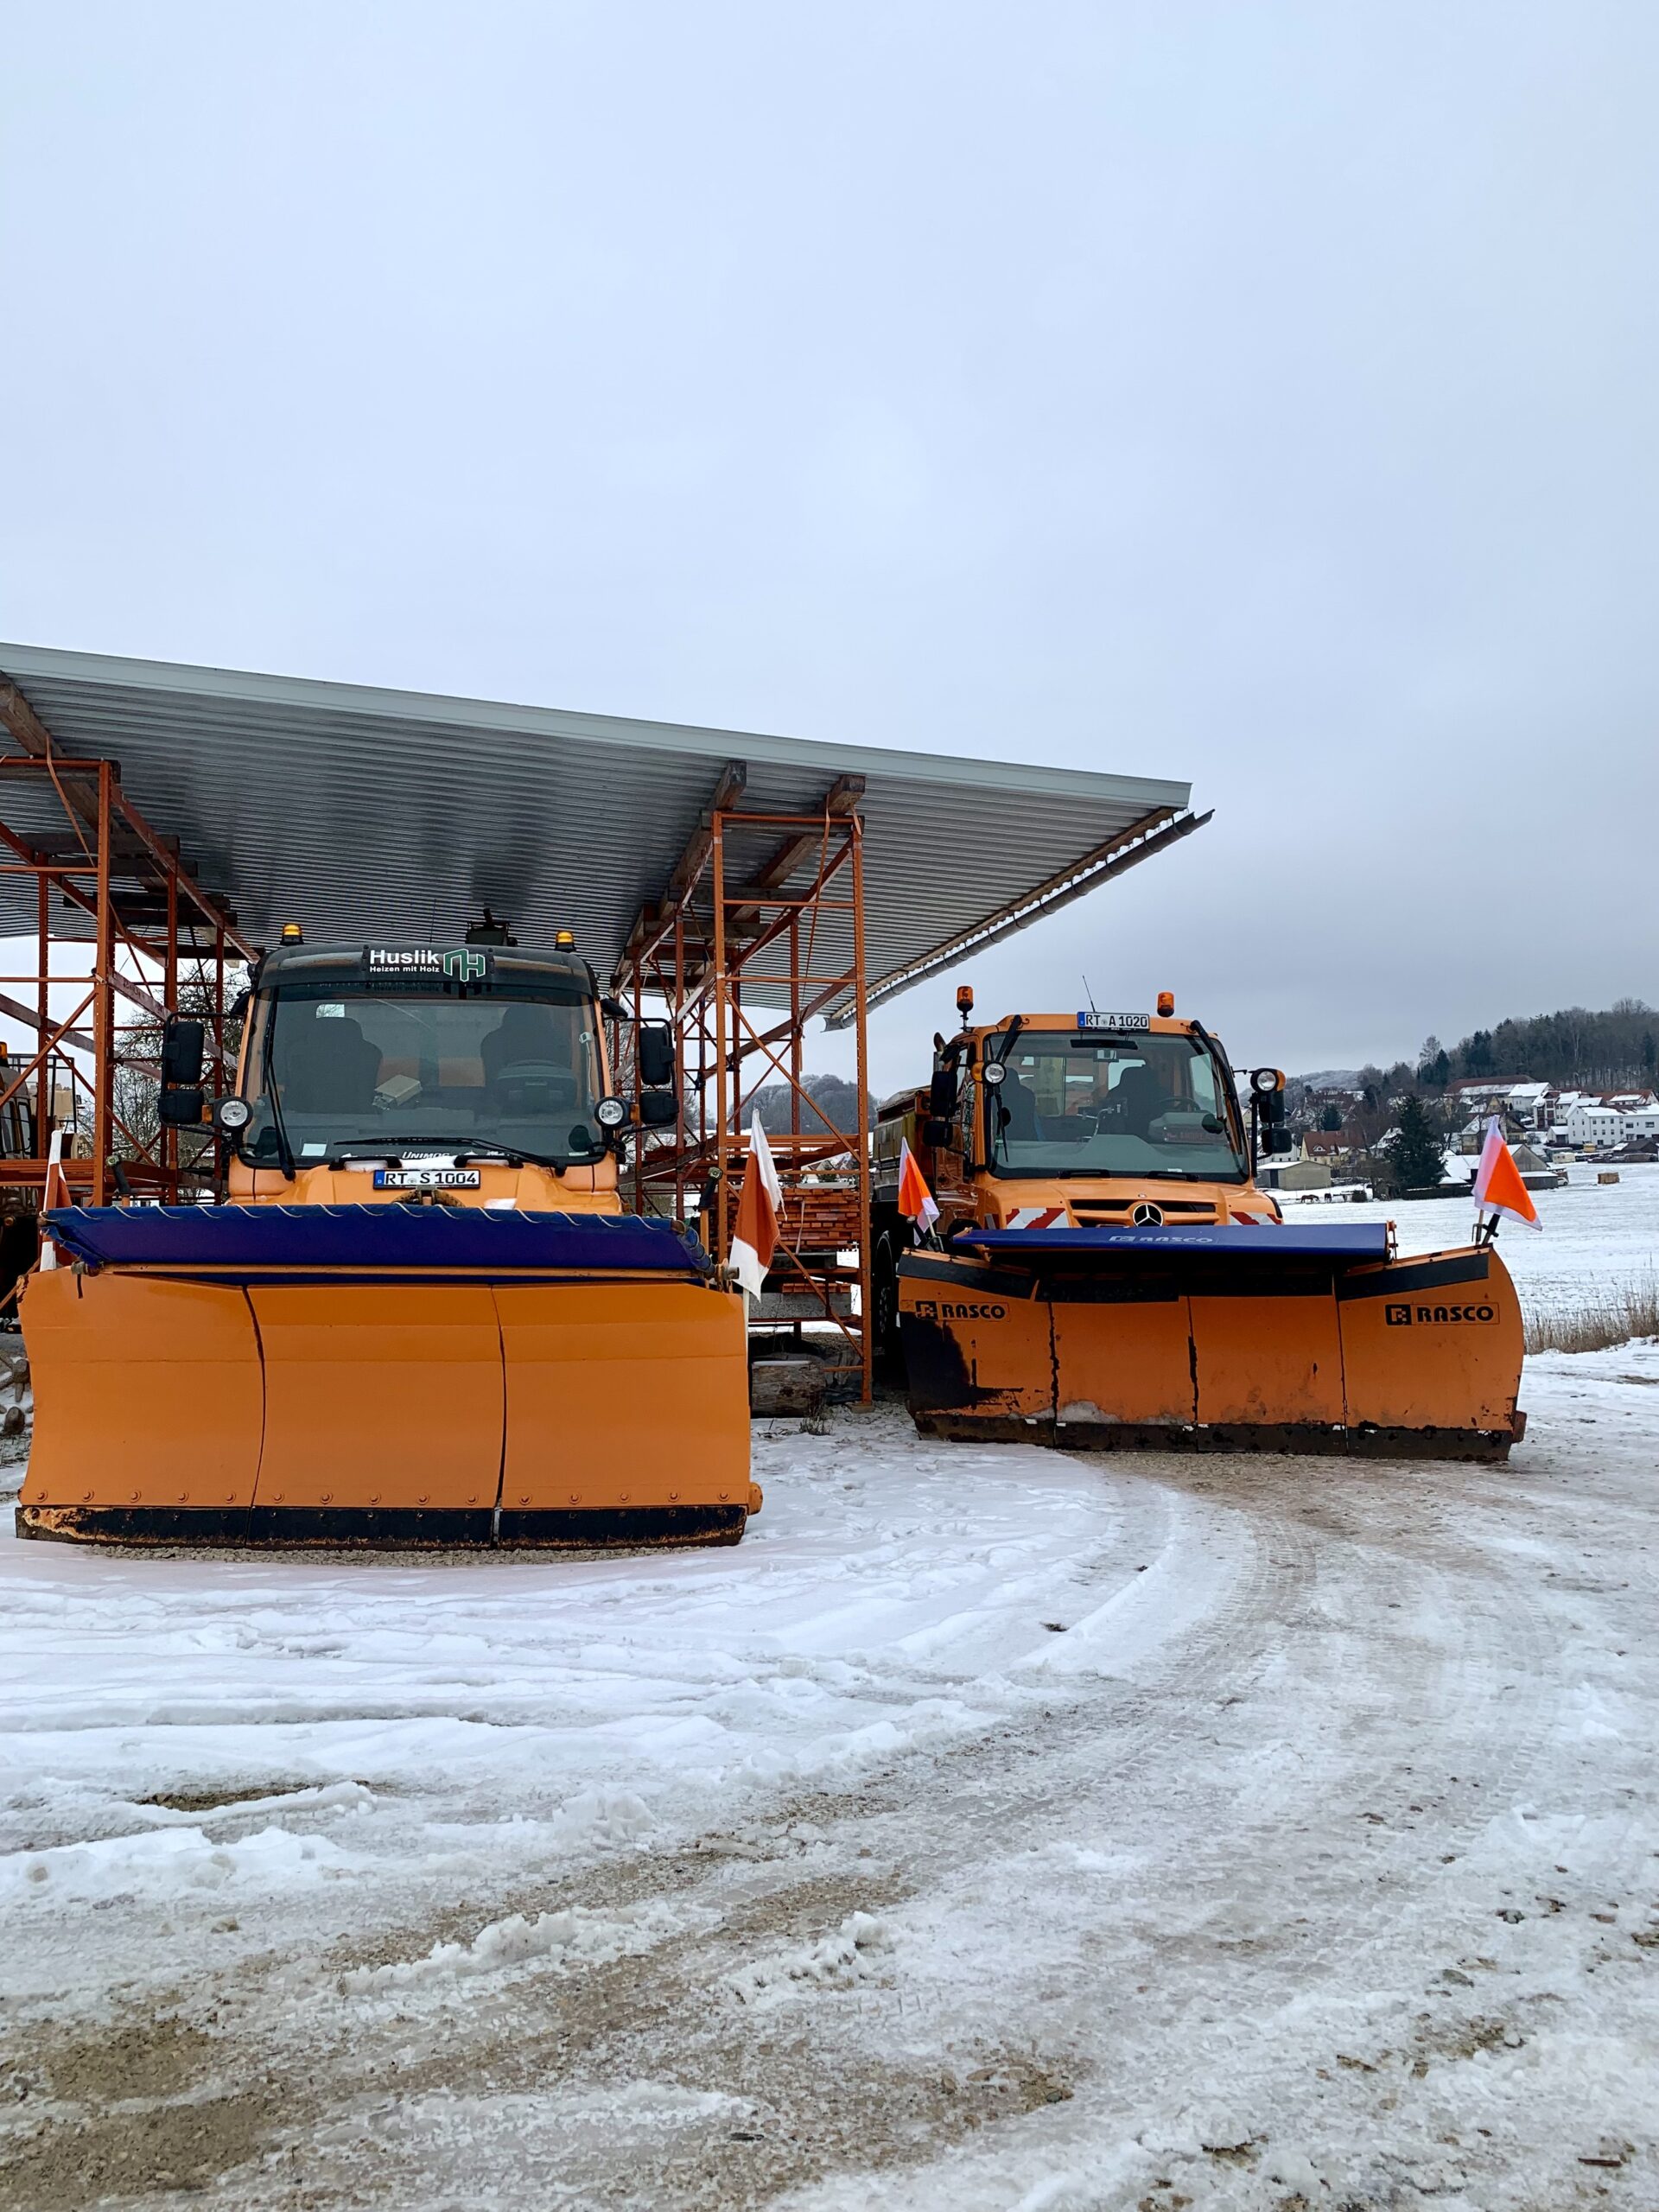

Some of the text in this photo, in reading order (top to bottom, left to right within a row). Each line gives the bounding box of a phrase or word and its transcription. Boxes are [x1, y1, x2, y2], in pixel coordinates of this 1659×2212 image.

[369, 950, 440, 964] Huslik
[1085, 1014, 1101, 1026] RT
[1109, 1015, 1116, 1027] A
[1119, 1016, 1147, 1027] 1020
[385, 1172, 476, 1185] RT S 1004
[941, 1303, 1007, 1319] RASCO
[1416, 1306, 1494, 1322] RASCO
